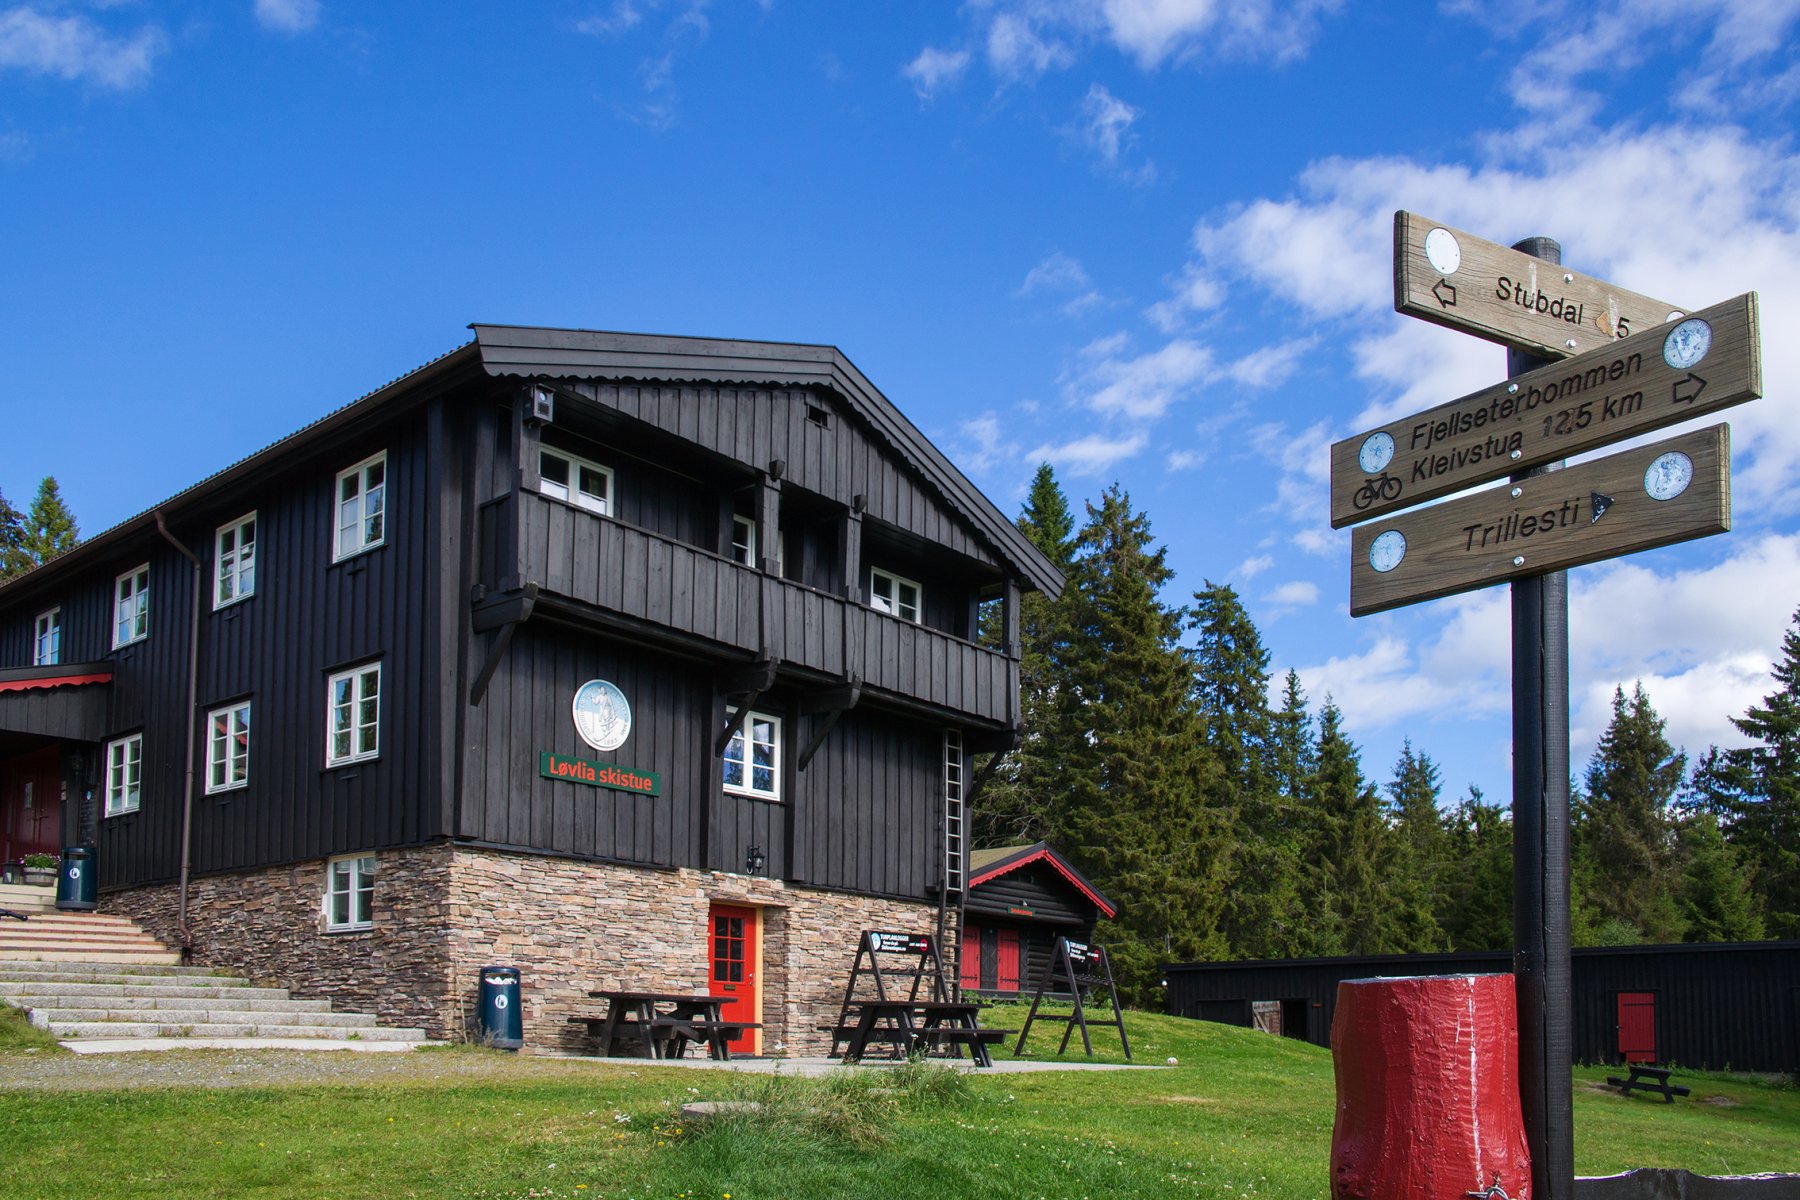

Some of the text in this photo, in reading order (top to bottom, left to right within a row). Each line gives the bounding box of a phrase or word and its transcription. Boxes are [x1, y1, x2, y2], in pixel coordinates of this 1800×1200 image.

[1495, 276, 1583, 325] Stubdal
[1410, 352, 1642, 450] Fjellseterbommen
[1411, 431, 1523, 482] Kleivstua
[1602, 390, 1643, 422] km
[1463, 497, 1581, 551] Trillesti
[549, 756, 653, 791] Løvlia skistue
